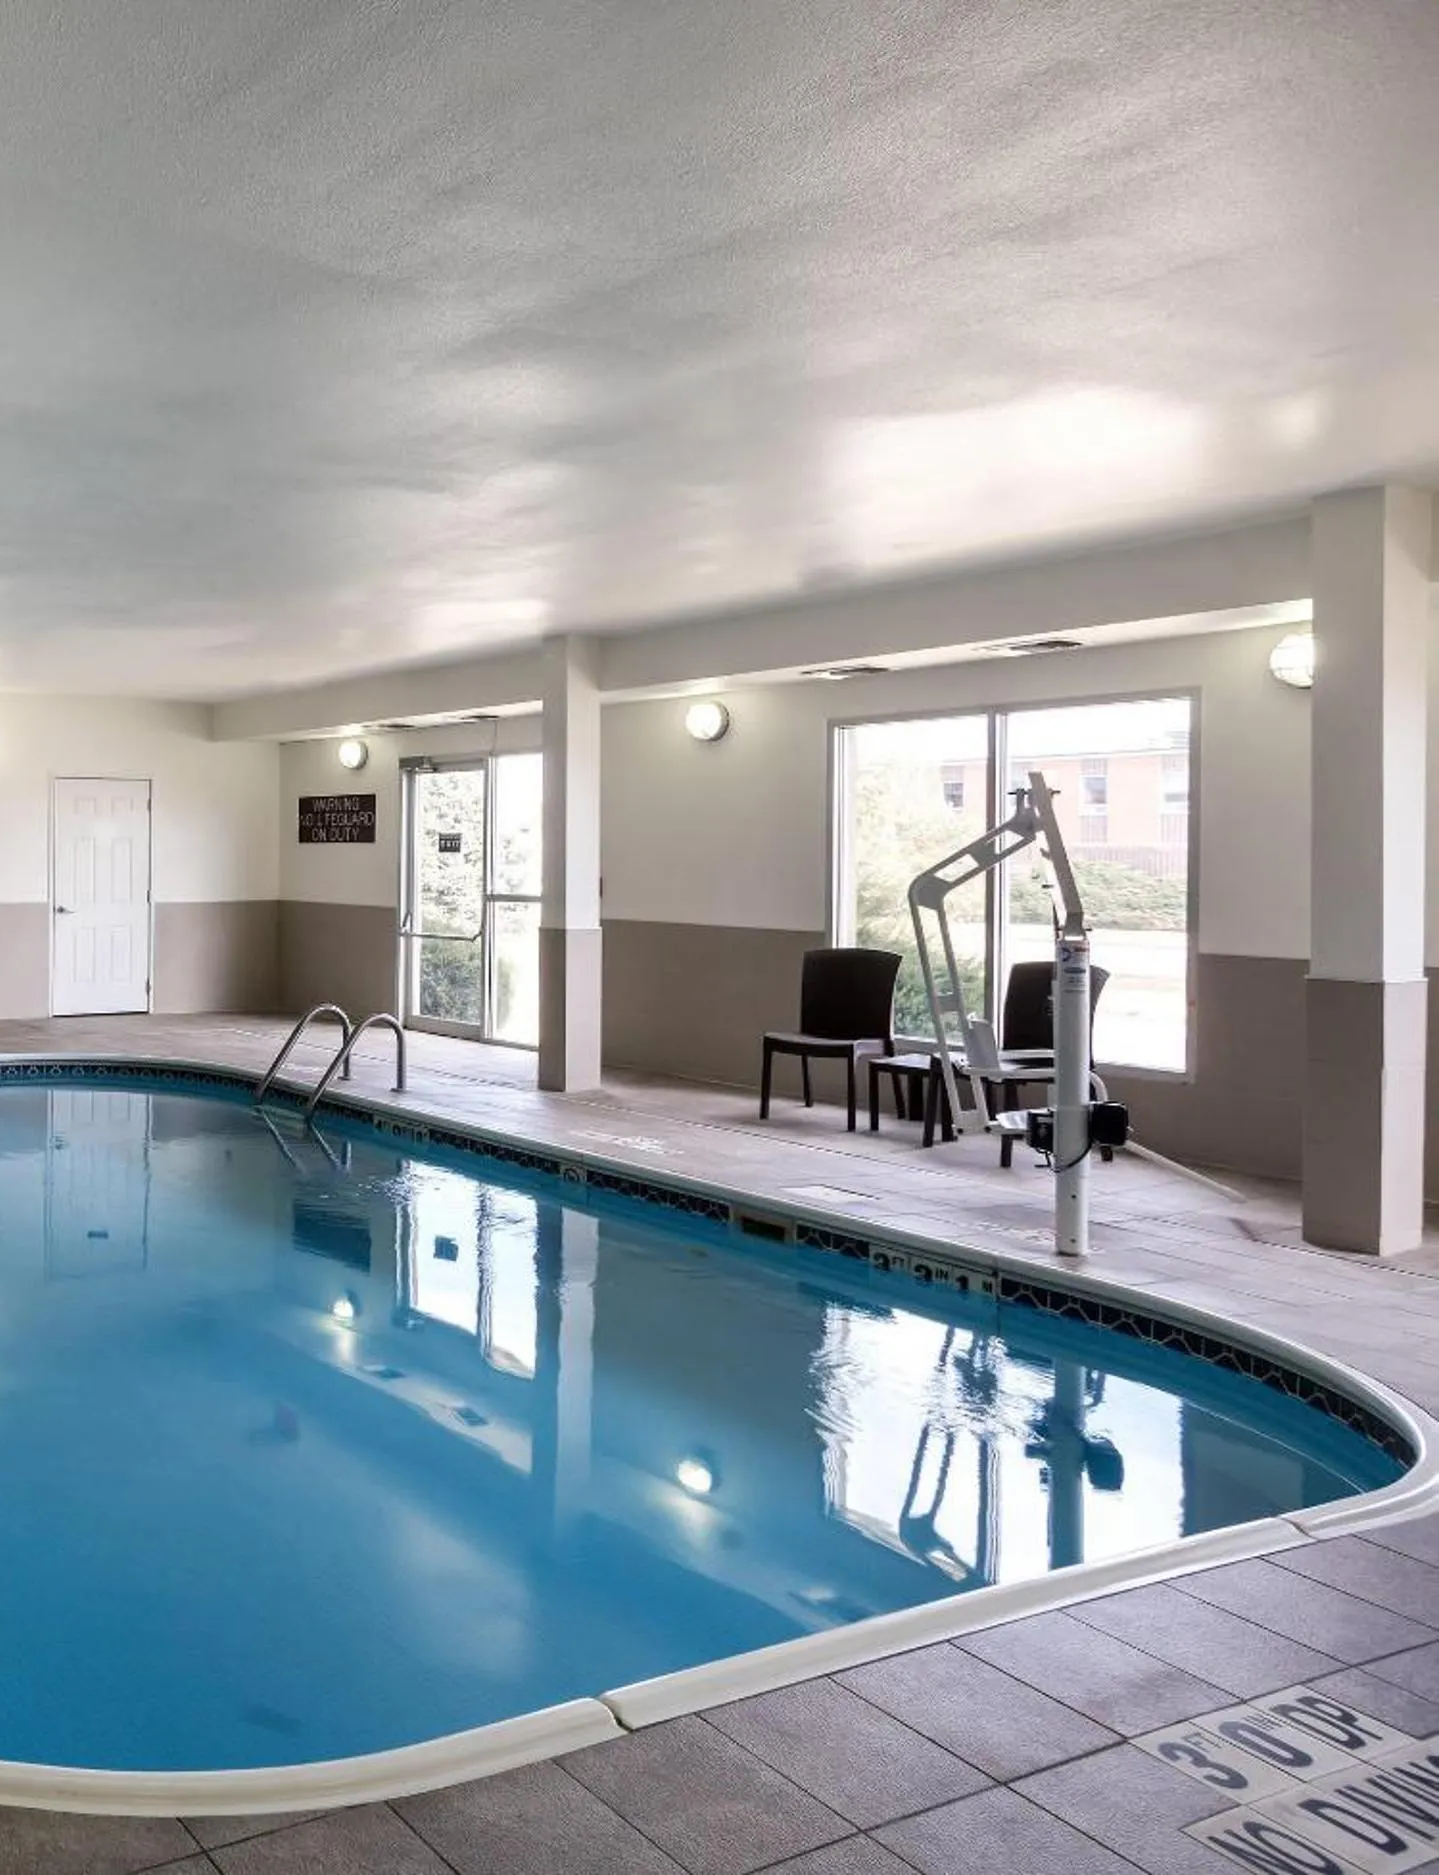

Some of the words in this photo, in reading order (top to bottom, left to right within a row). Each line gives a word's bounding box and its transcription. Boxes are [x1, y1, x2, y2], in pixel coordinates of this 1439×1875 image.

[312, 796, 360, 812] WARNNG
[317, 811, 375, 826] LFEGUARD
[311, 827, 327, 841] ON
[328, 827, 360, 841] DUTY
[1268, 1696, 1383, 1749] DP
[1206, 1821, 1344, 1875] NO
[1297, 1755, 1439, 1856] DIVI
